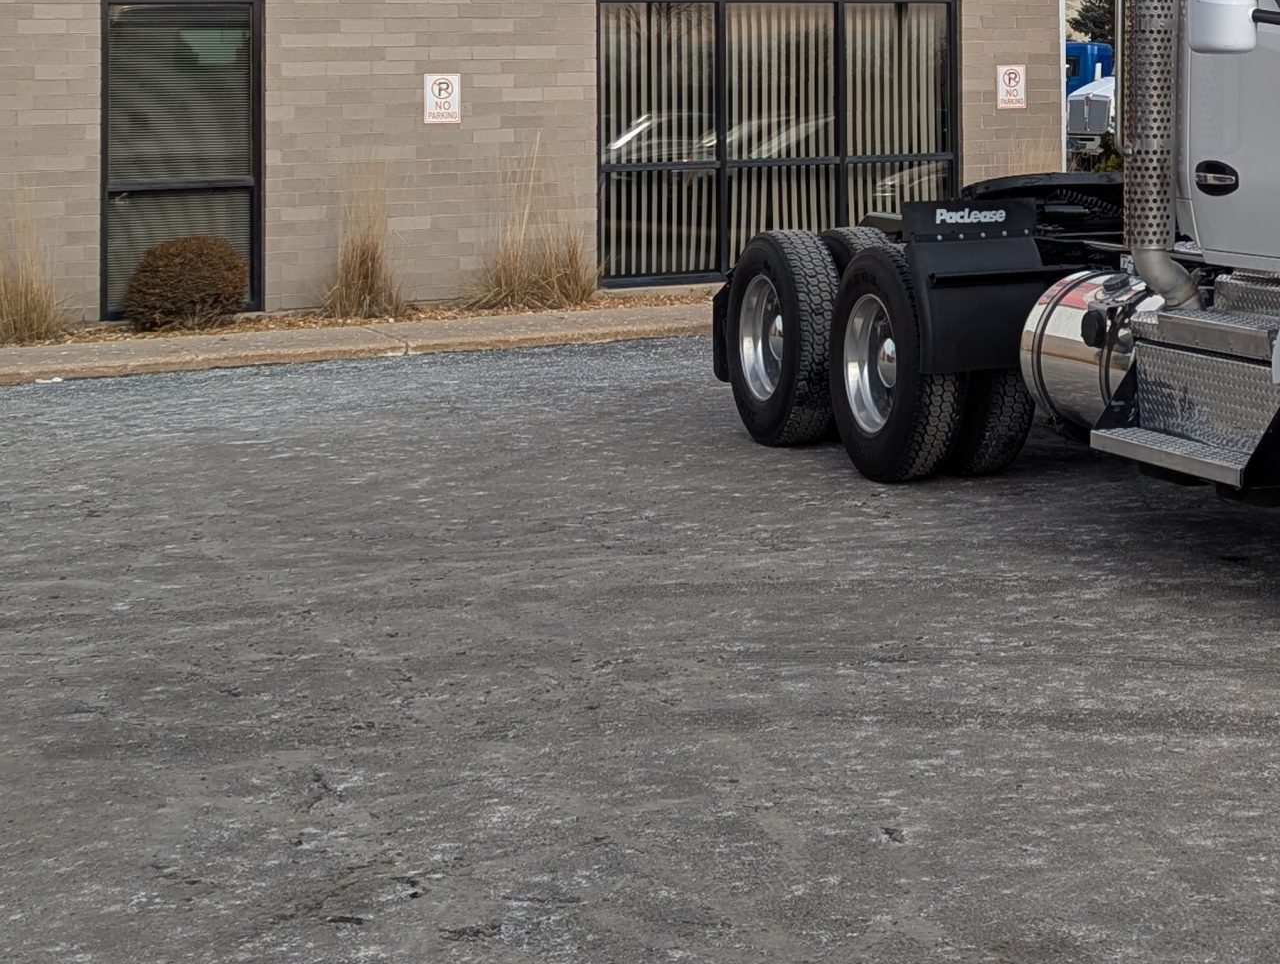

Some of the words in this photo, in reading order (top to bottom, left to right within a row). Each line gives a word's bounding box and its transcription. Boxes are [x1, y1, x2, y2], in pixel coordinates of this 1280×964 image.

[1006, 89, 1018, 97] NO
[435, 101, 451, 110] NO
[935, 208, 1007, 224] PacLease
